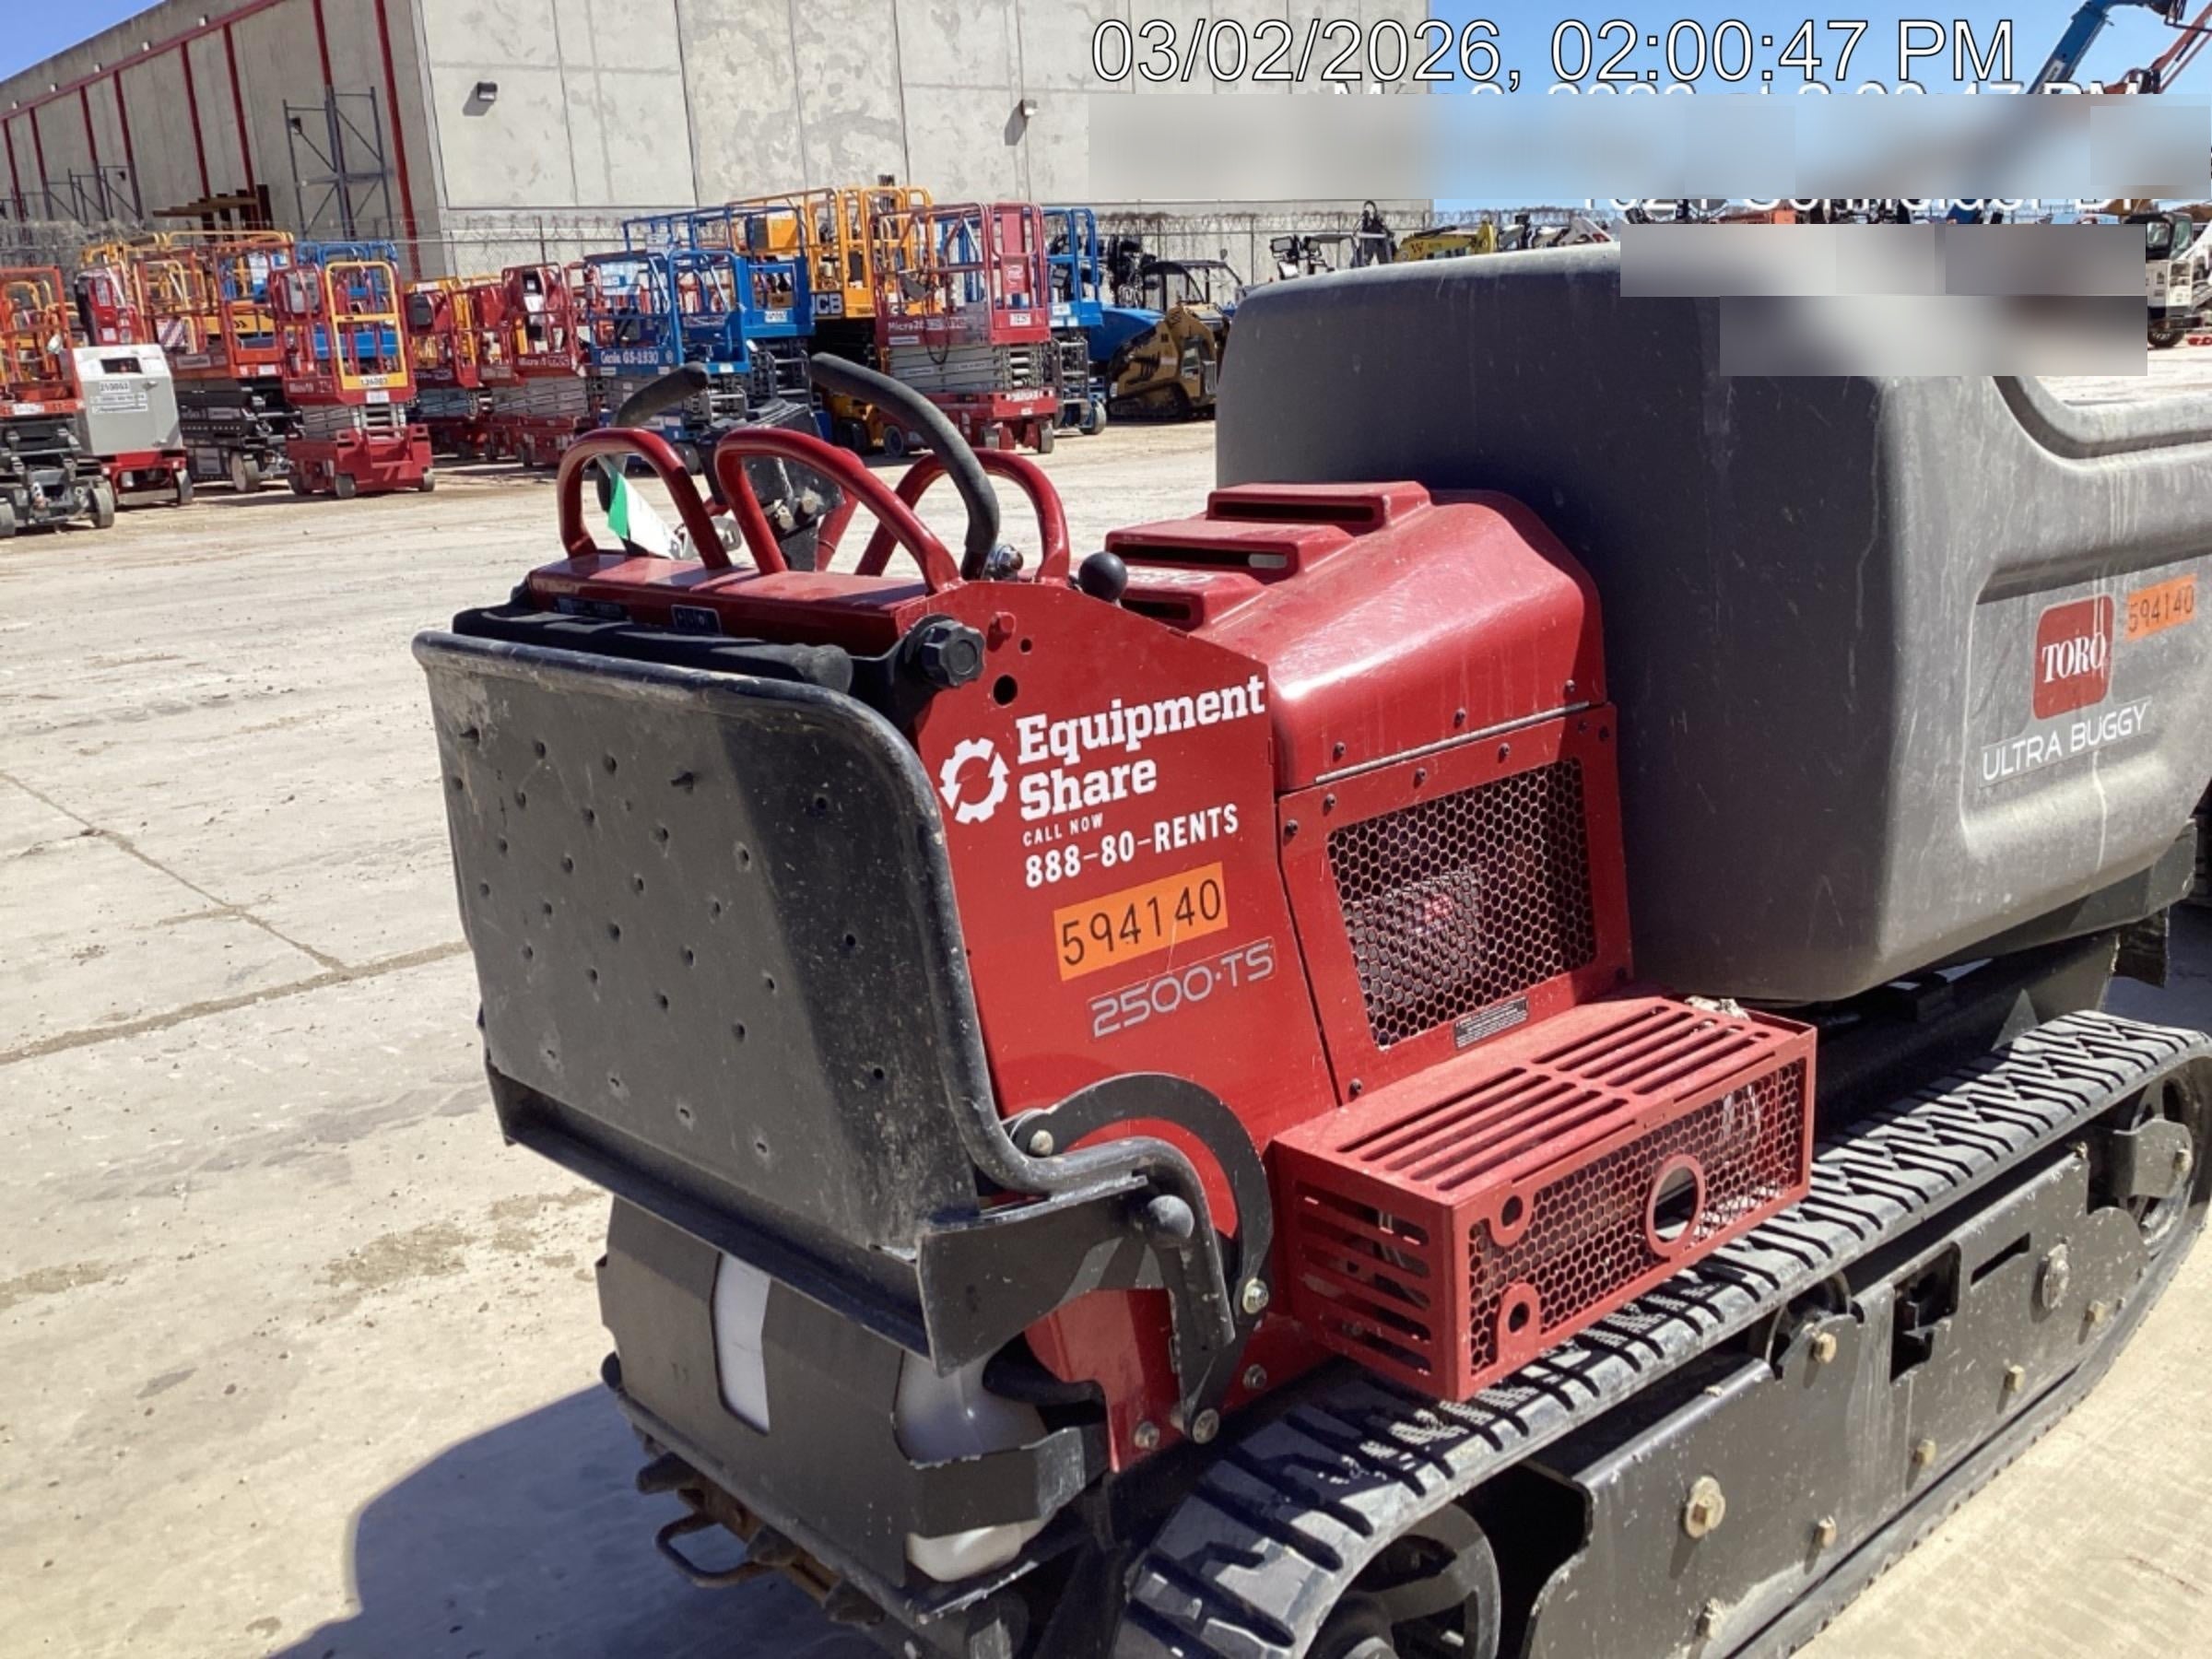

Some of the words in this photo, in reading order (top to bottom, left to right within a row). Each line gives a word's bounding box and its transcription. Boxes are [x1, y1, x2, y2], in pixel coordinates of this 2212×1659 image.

[2127, 584, 2194, 633] 594140
[2041, 633, 2107, 683] TORO
[1015, 674, 1266, 767] Equipment
[1983, 730, 2063, 781] ULTRA
[2070, 702, 2148, 753] BUGGY
[1018, 758, 1159, 822] Share
[1022, 823, 1064, 848] CALL
[1069, 813, 1104, 838] NOW
[1025, 803, 1241, 889] 888-80-RENTS
[1061, 877, 1223, 967] 594140
